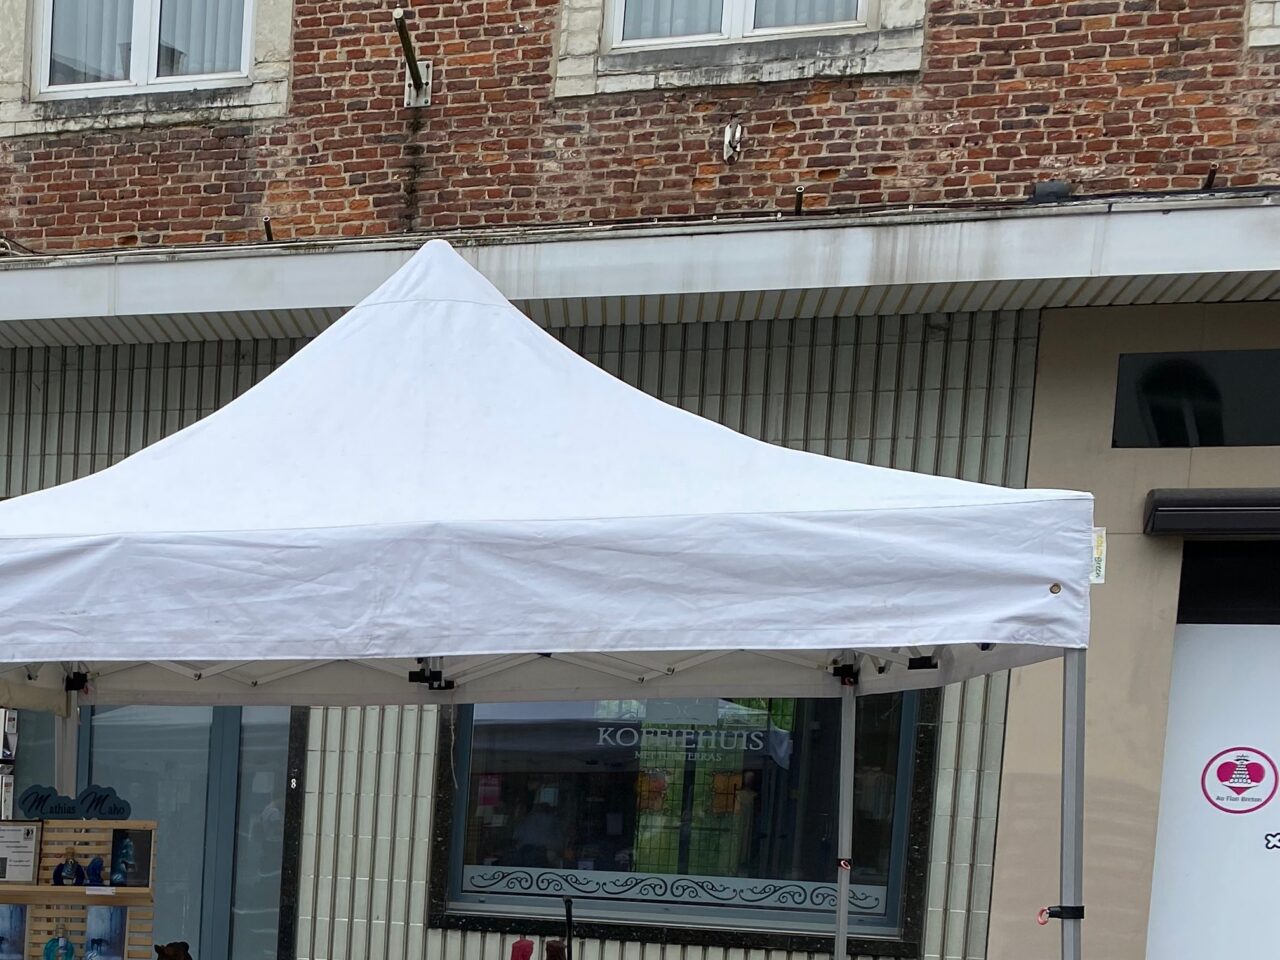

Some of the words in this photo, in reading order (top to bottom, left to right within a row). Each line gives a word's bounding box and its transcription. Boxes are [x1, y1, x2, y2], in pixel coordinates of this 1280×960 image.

[596, 727, 764, 750] KOFFIEHUIS
[291, 778, 297, 789] 8
[22, 791, 76, 815] Mathias
[80, 791, 125, 816] Maho
